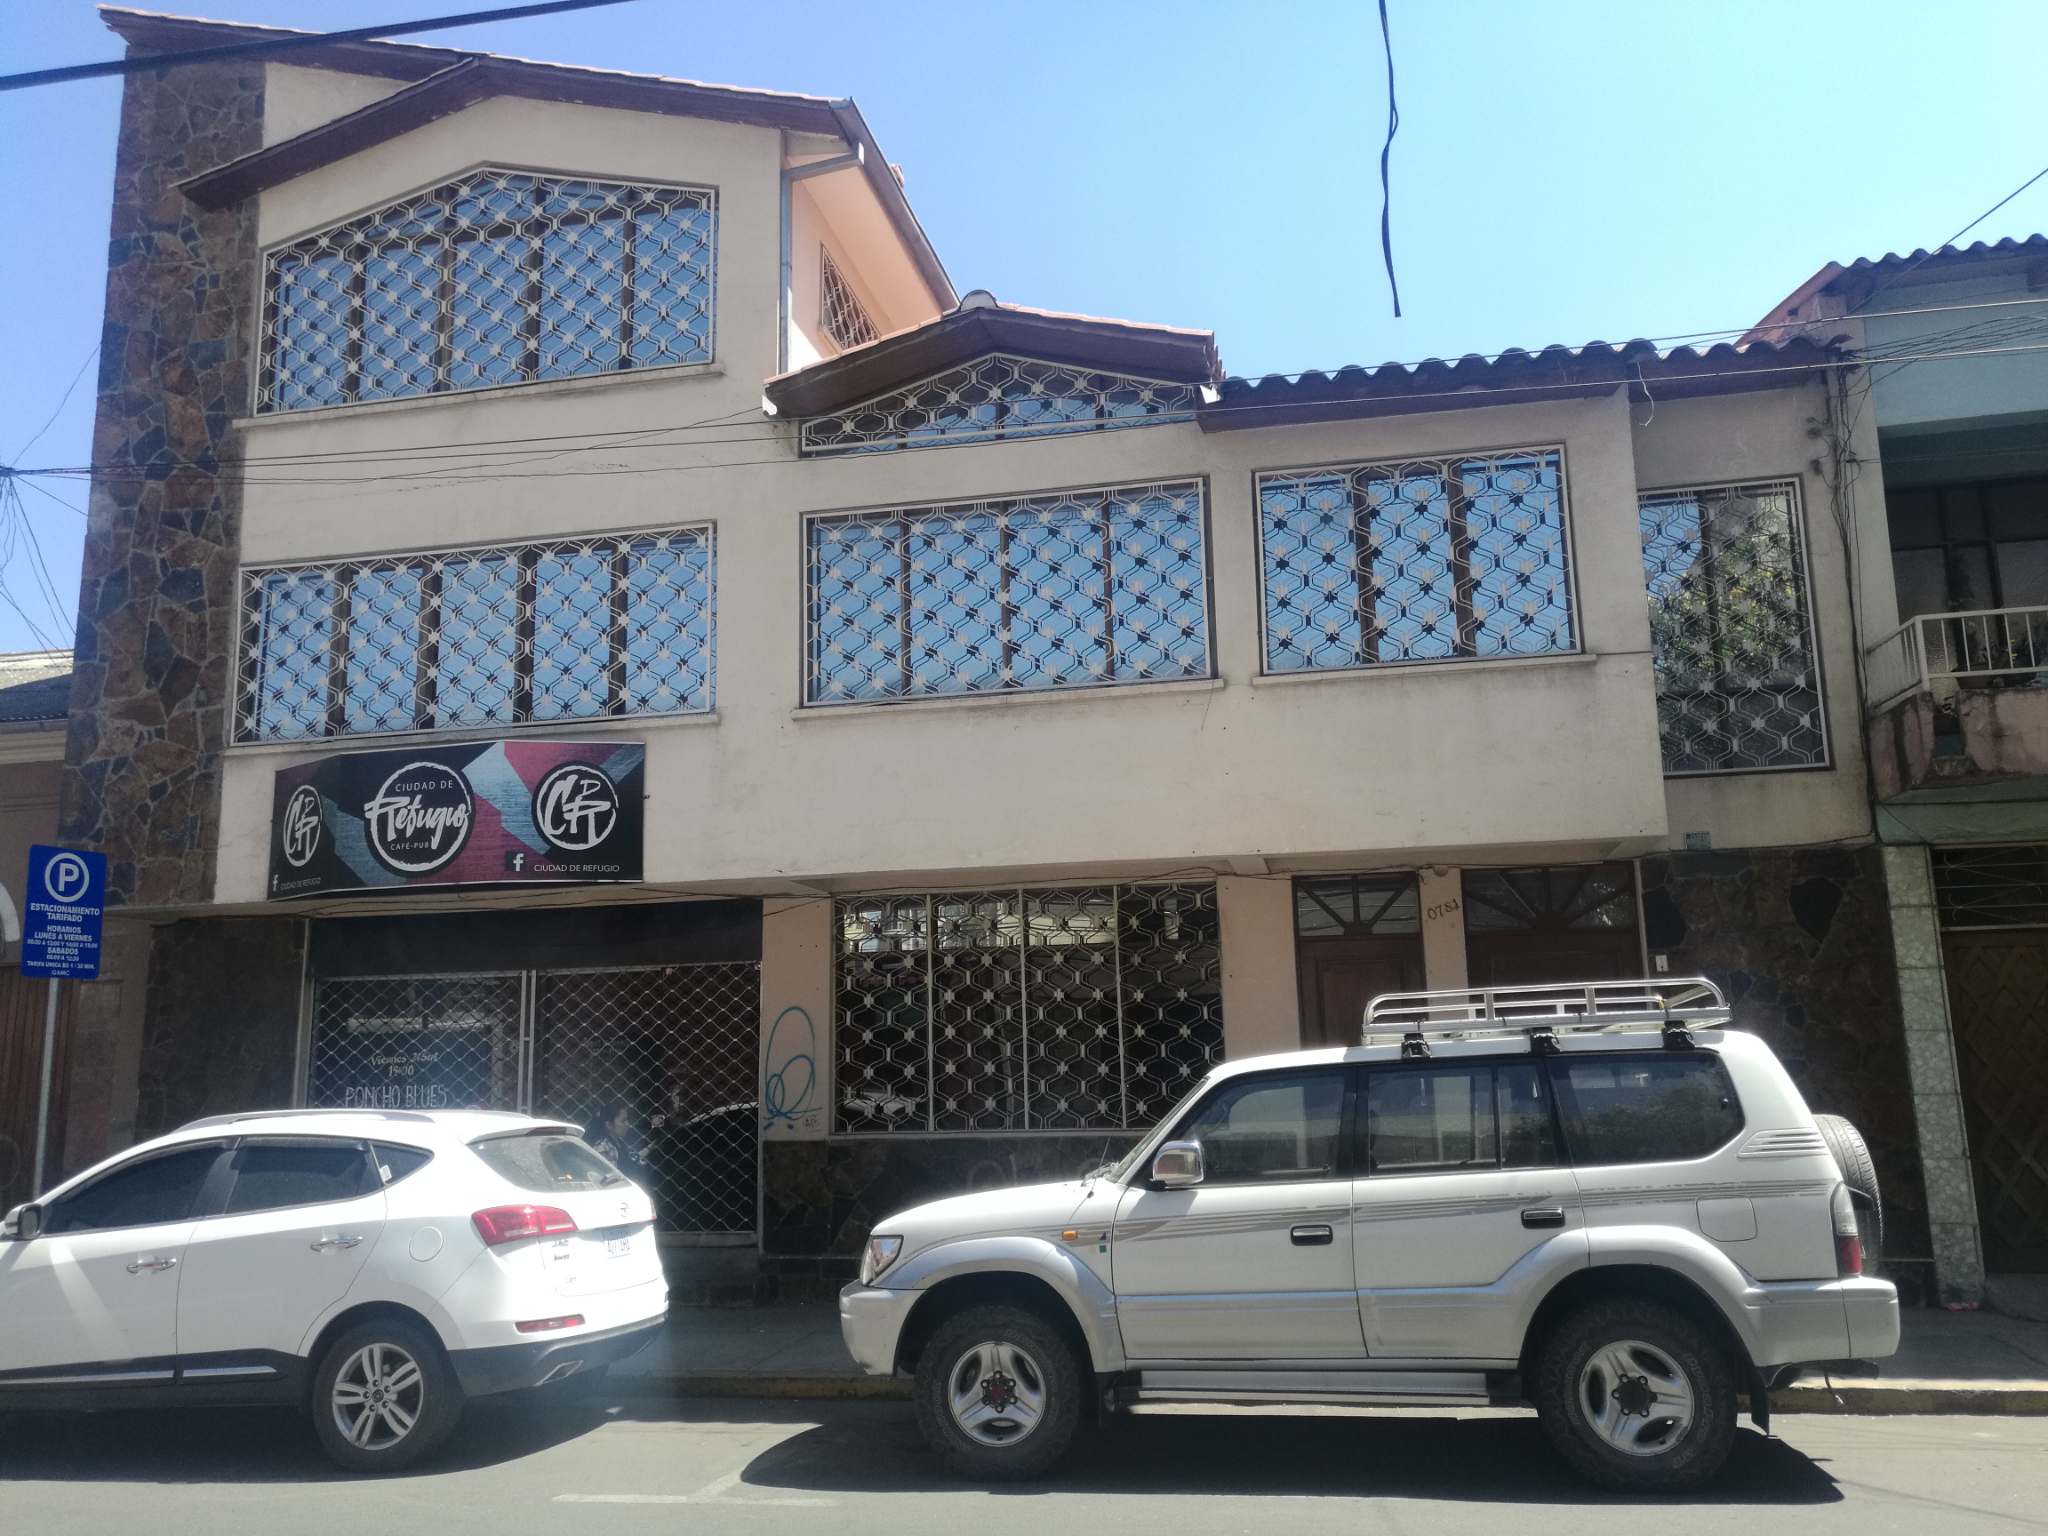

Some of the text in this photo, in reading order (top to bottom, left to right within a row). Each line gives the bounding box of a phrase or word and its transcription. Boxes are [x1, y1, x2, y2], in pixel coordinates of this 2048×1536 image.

[395, 779, 454, 792] CIUDAD DE
[363, 794, 467, 850] Refugio
[390, 840, 430, 851] CAFÉ-PUB
[534, 864, 567, 872] CIUDAD
[569, 864, 581, 872] DE
[583, 864, 620, 872] REFUGIO
[58, 862, 80, 892] P
[30, 903, 100, 916] ESTACIONAMIENTO
[47, 913, 83, 923] TARIFADO
[47, 925, 82, 934] HORARIOS
[34, 932, 56, 940] LUNES
[64, 934, 93, 942] VIERNES
[47, 947, 79, 955] SABADOS
[345, 1084, 447, 1109] PONCHO BLUES
